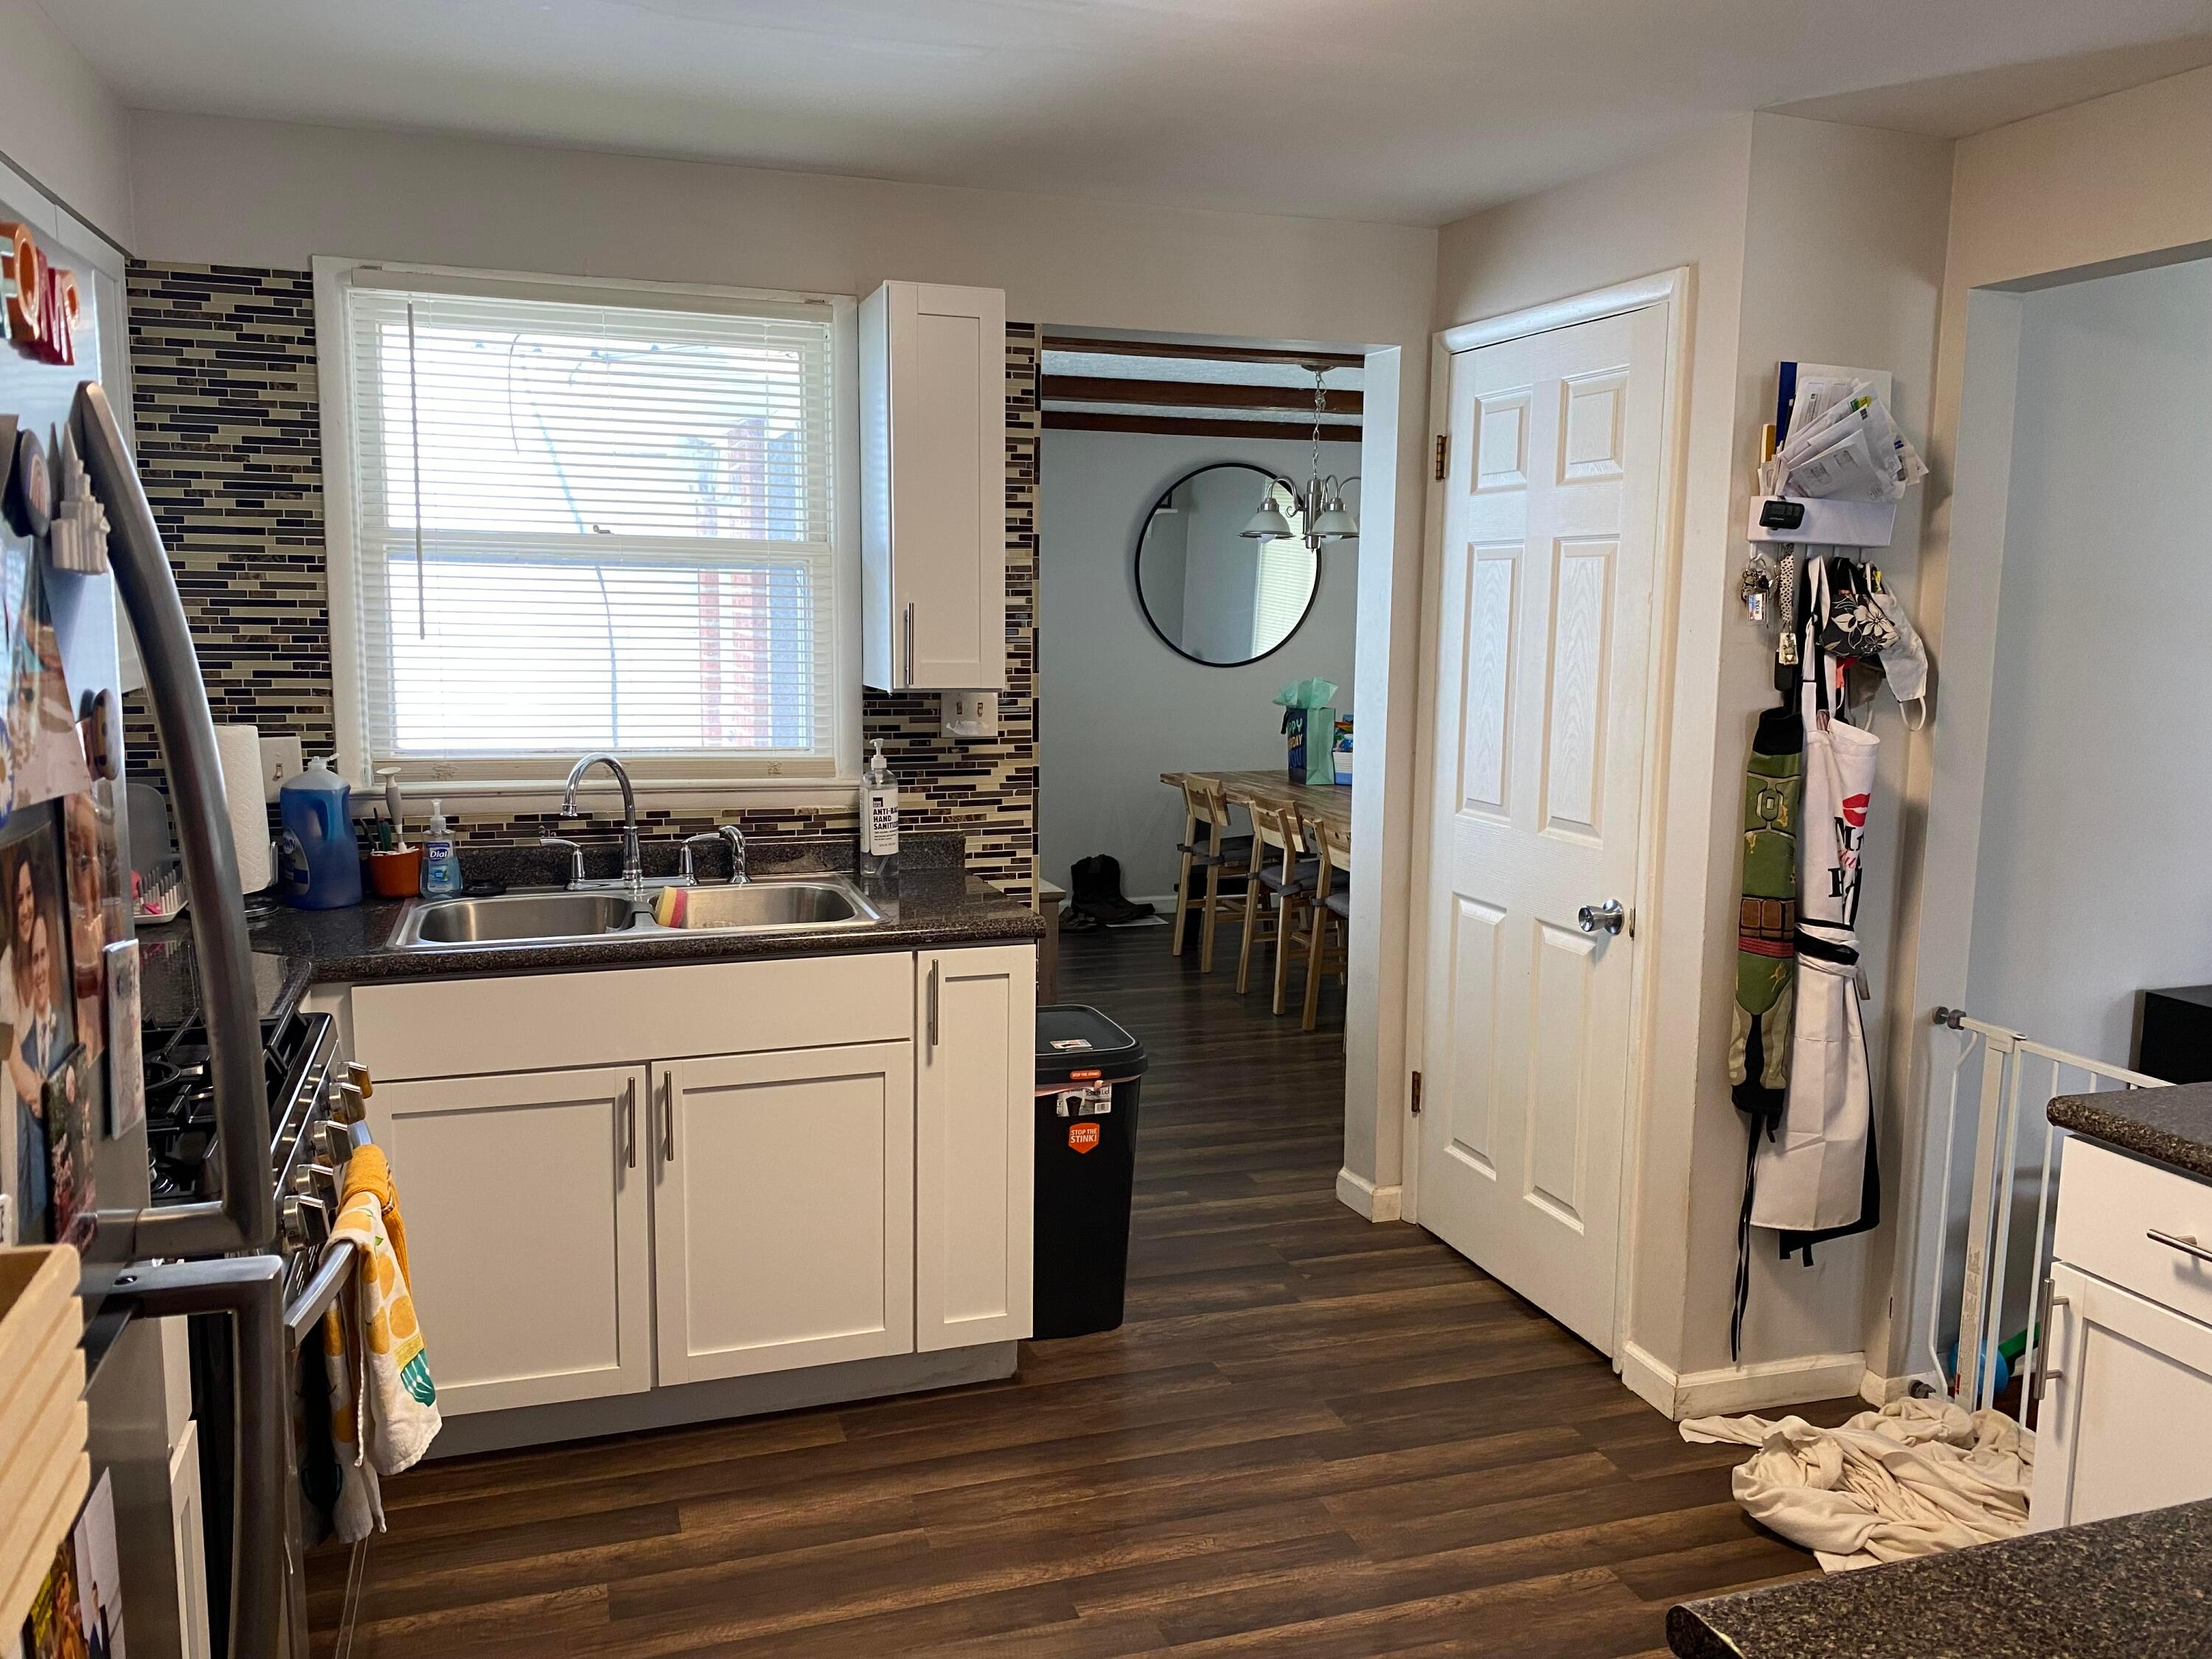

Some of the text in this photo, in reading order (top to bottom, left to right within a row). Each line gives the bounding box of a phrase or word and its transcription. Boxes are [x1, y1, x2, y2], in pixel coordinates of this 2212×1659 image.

[873, 815, 892, 823] HAND
[429, 850, 448, 858] Dial
[1102, 1087, 1110, 1095] Lid
[1070, 1134, 1098, 1144] STINK!
